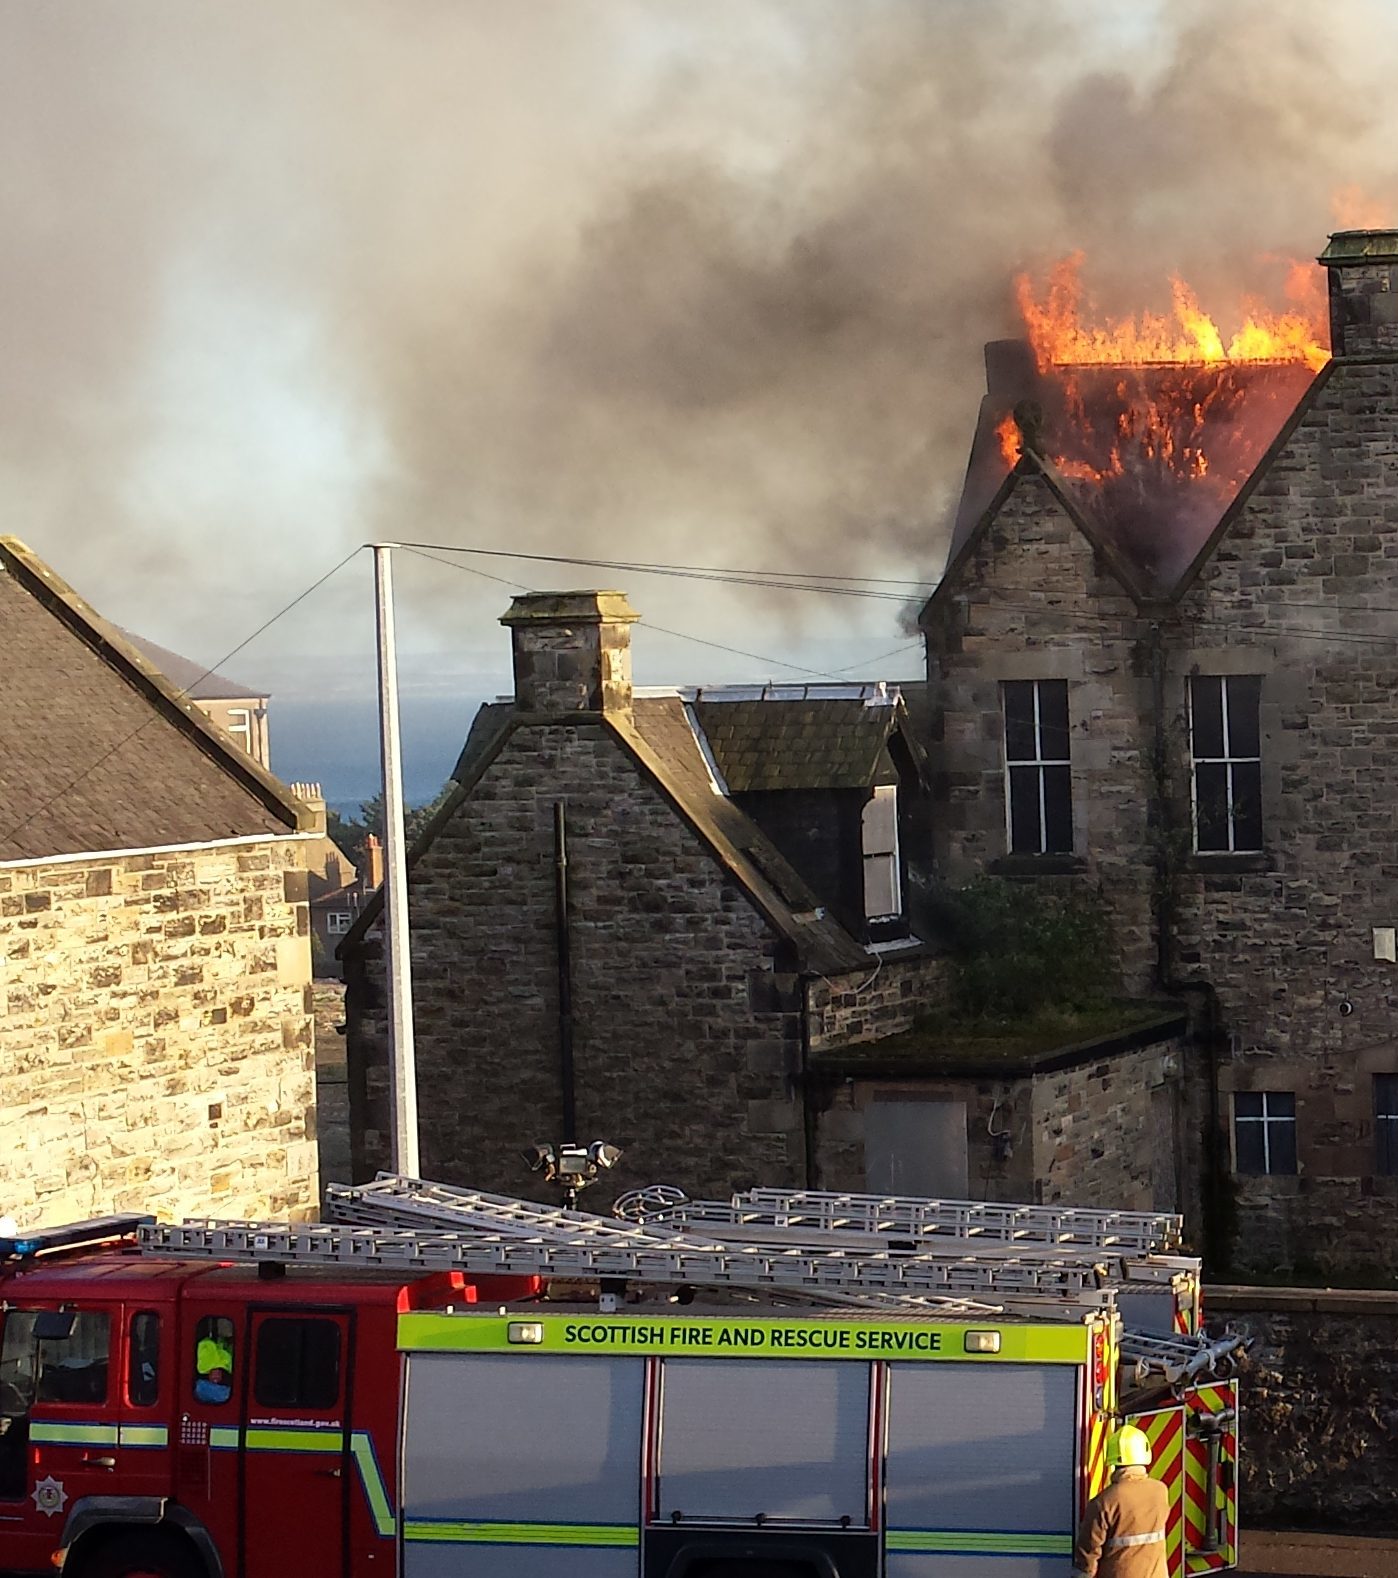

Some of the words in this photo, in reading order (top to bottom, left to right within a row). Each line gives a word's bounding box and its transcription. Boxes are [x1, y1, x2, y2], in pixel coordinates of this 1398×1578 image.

[565, 1325, 664, 1345] SCOTTISH
[670, 1327, 713, 1346] FIRE
[717, 1328, 765, 1347] AND
[771, 1329, 850, 1349] RESCUE
[855, 1331, 941, 1351] SERVICE
